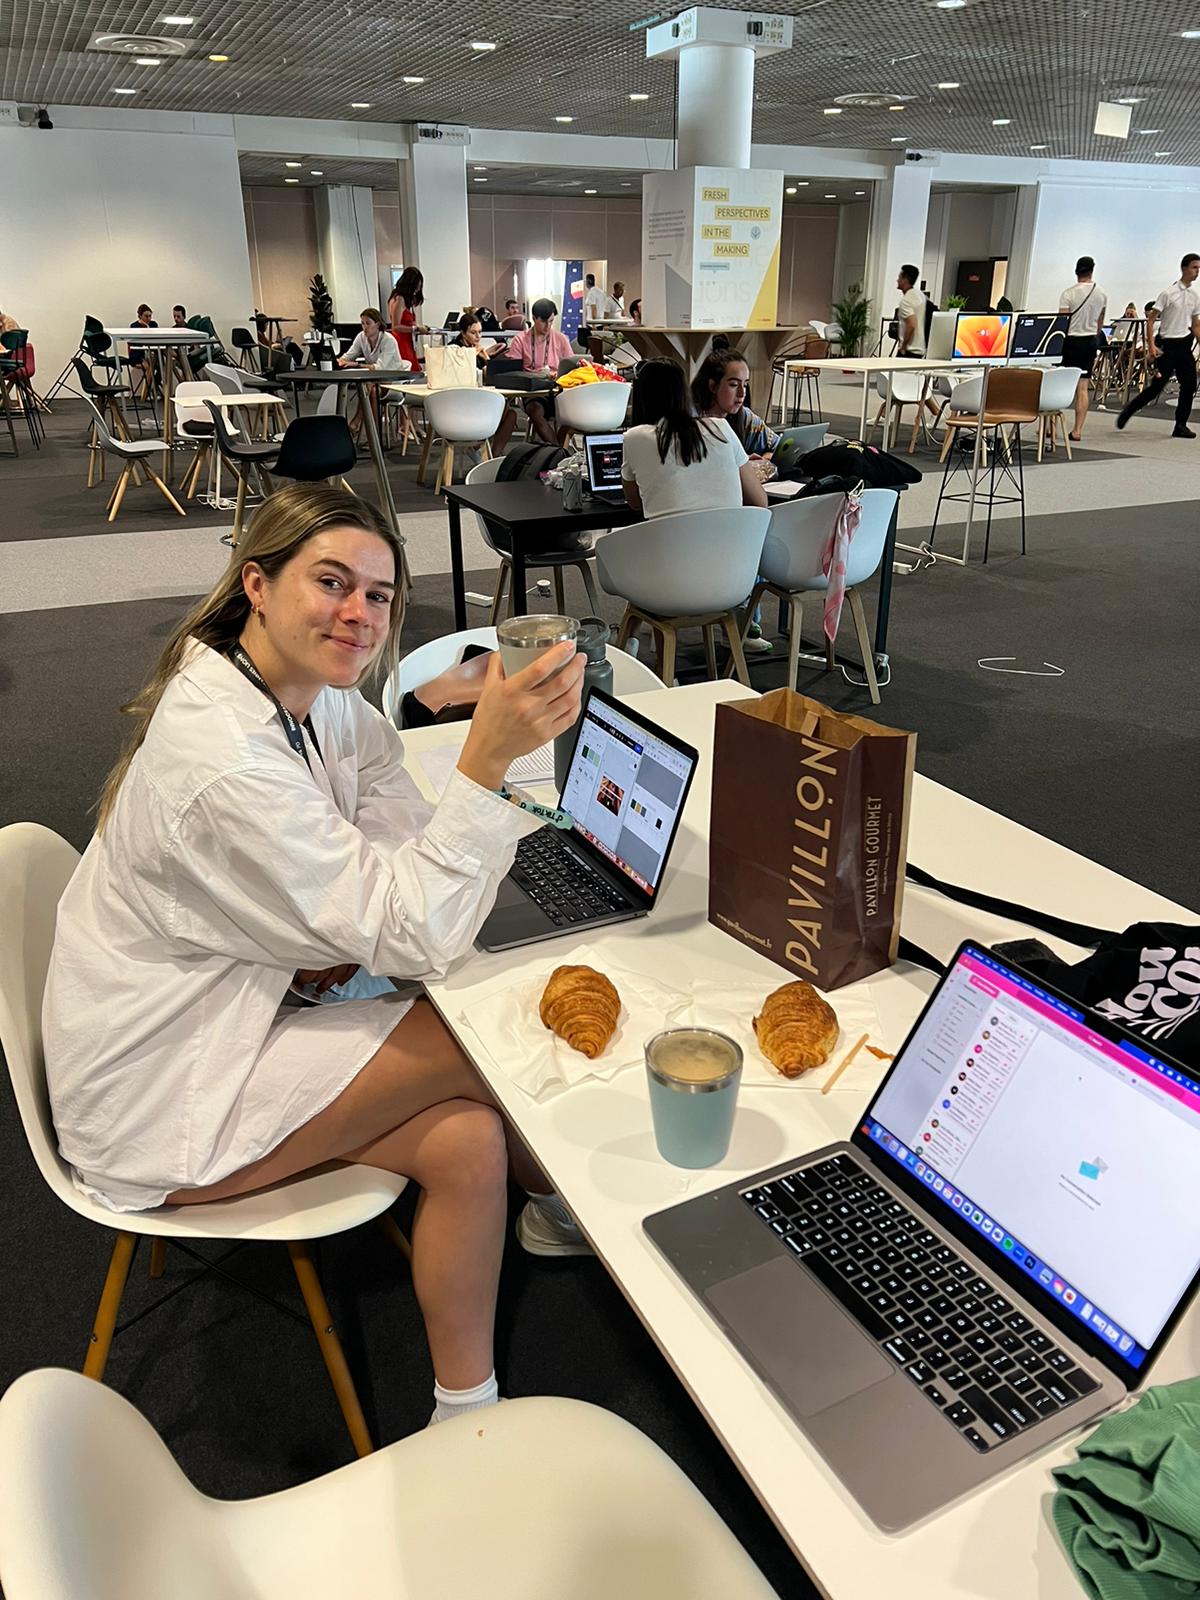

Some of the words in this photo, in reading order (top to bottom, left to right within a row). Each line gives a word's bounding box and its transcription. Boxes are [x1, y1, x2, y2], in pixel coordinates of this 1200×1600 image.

[704, 190, 727, 200] FRESH
[717, 207, 769, 218] PERSPECTIVES
[704, 228, 714, 237] IN
[714, 228, 729, 238] THE
[716, 245, 748, 255] MAKING
[866, 796, 882, 855] GOURMET
[866, 858, 880, 917] PAVILLON
